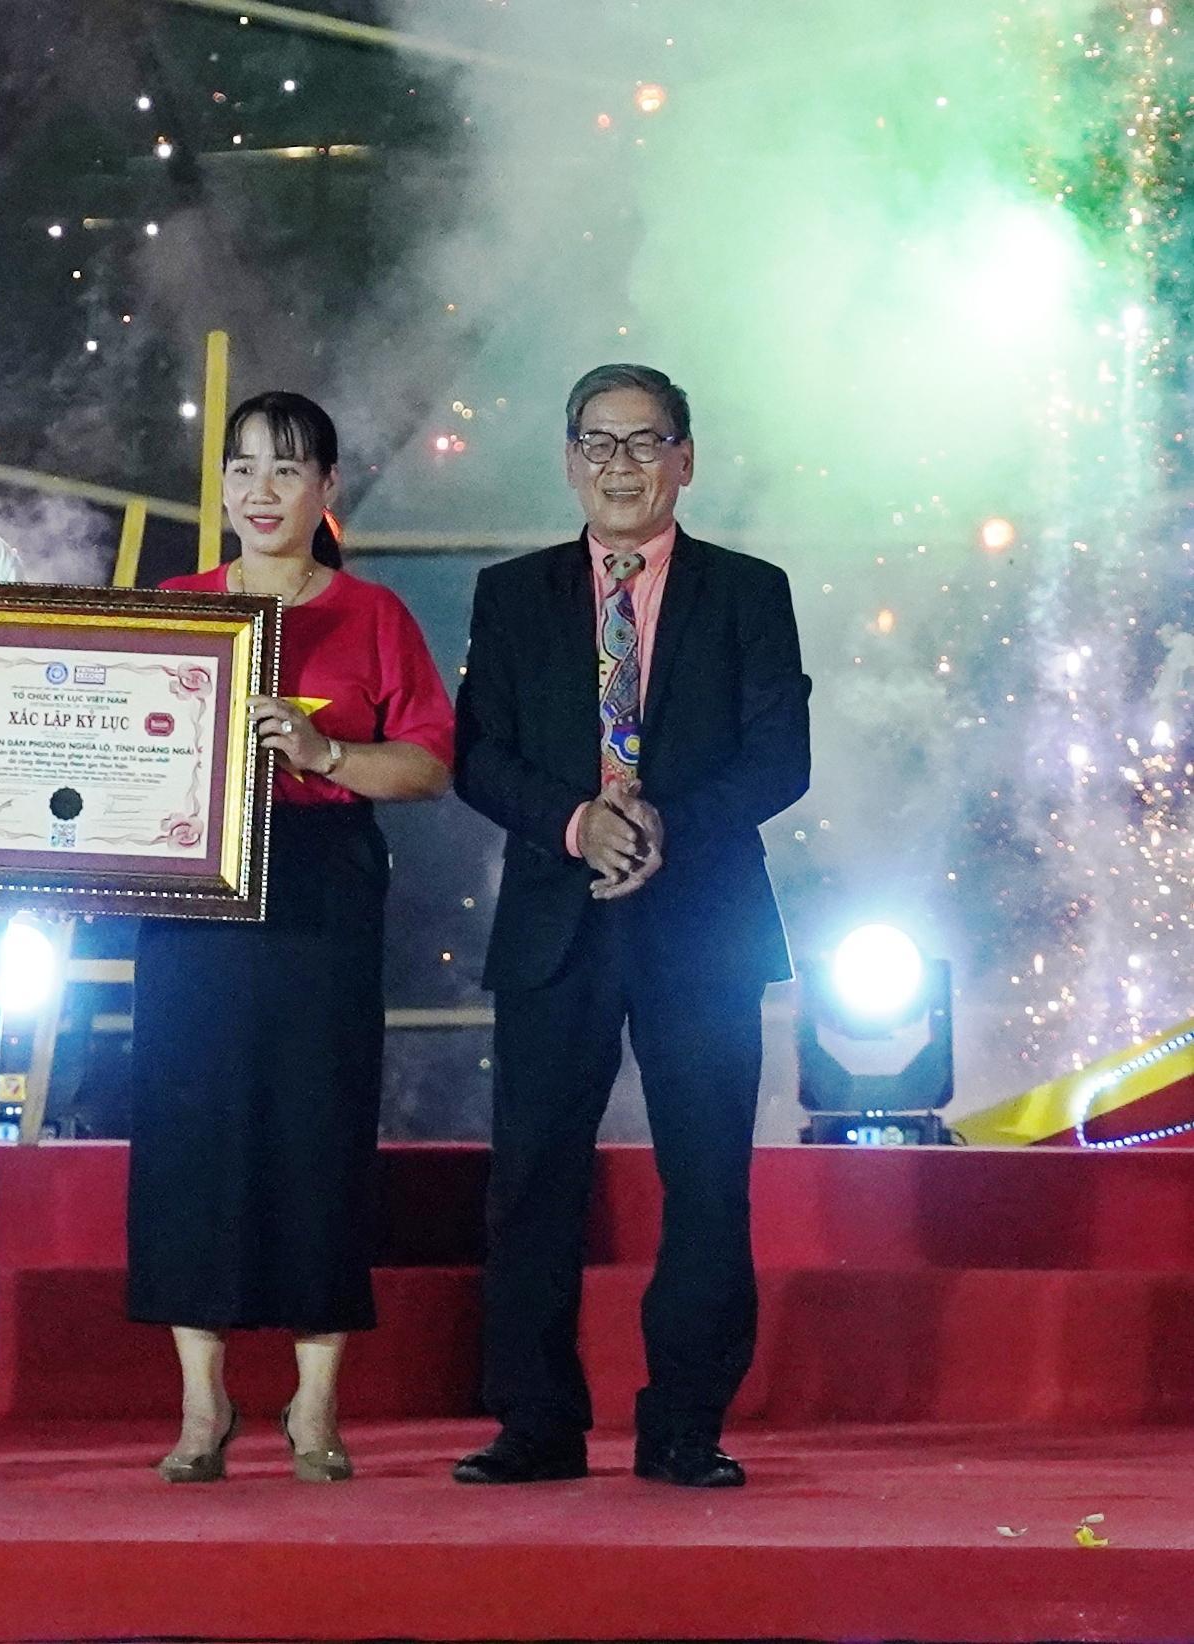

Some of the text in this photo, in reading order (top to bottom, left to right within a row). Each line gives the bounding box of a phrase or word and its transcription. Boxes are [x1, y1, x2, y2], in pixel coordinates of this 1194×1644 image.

[8, 707, 39, 726] XÁC
[44, 709, 71, 730] LẬP
[76, 707, 96, 728] KỶ
[101, 715, 130, 733] LỤC
